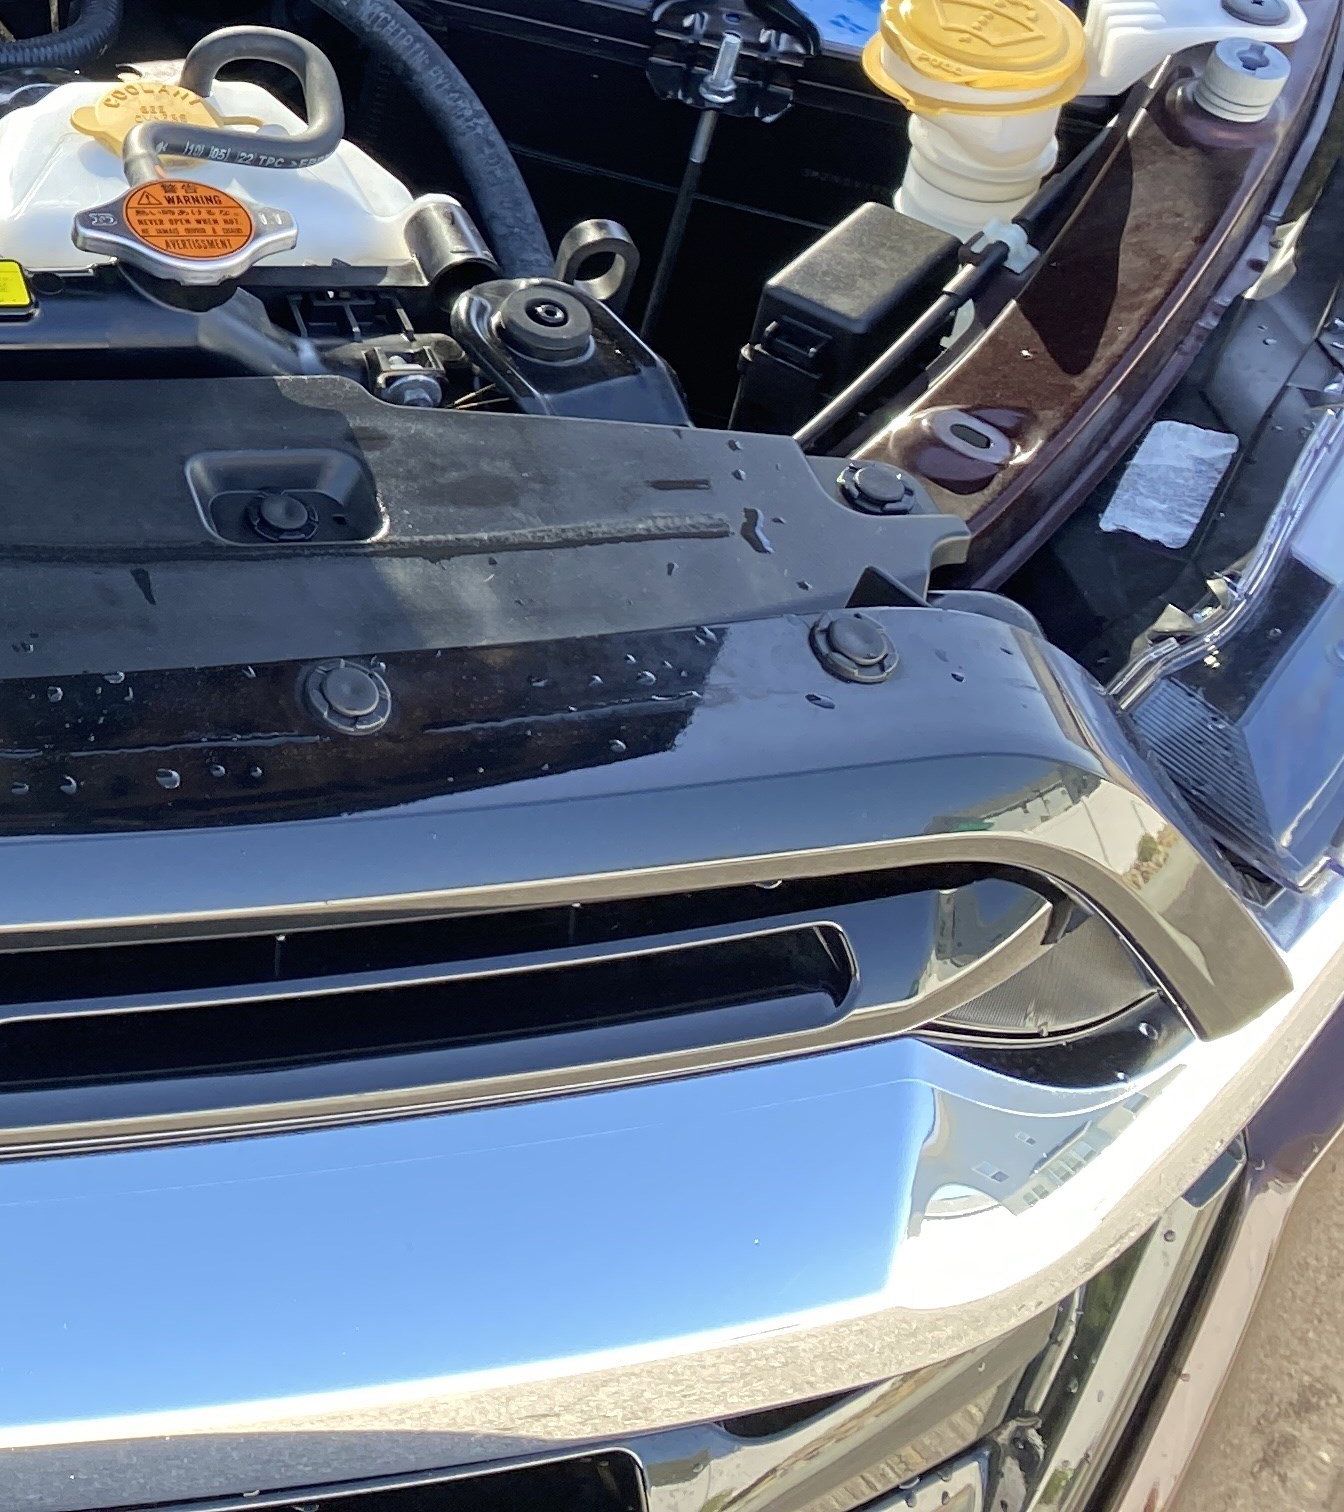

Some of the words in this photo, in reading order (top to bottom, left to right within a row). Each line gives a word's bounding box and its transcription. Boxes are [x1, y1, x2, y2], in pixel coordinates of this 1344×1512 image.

[103, 85, 201, 108] COOLANT
[258, 155, 285, 168] TPC
[164, 195, 223, 205] WARNING
[137, 218, 164, 226] NEVER
[168, 218, 191, 226] OPEN
[194, 218, 219, 226] WHEN
